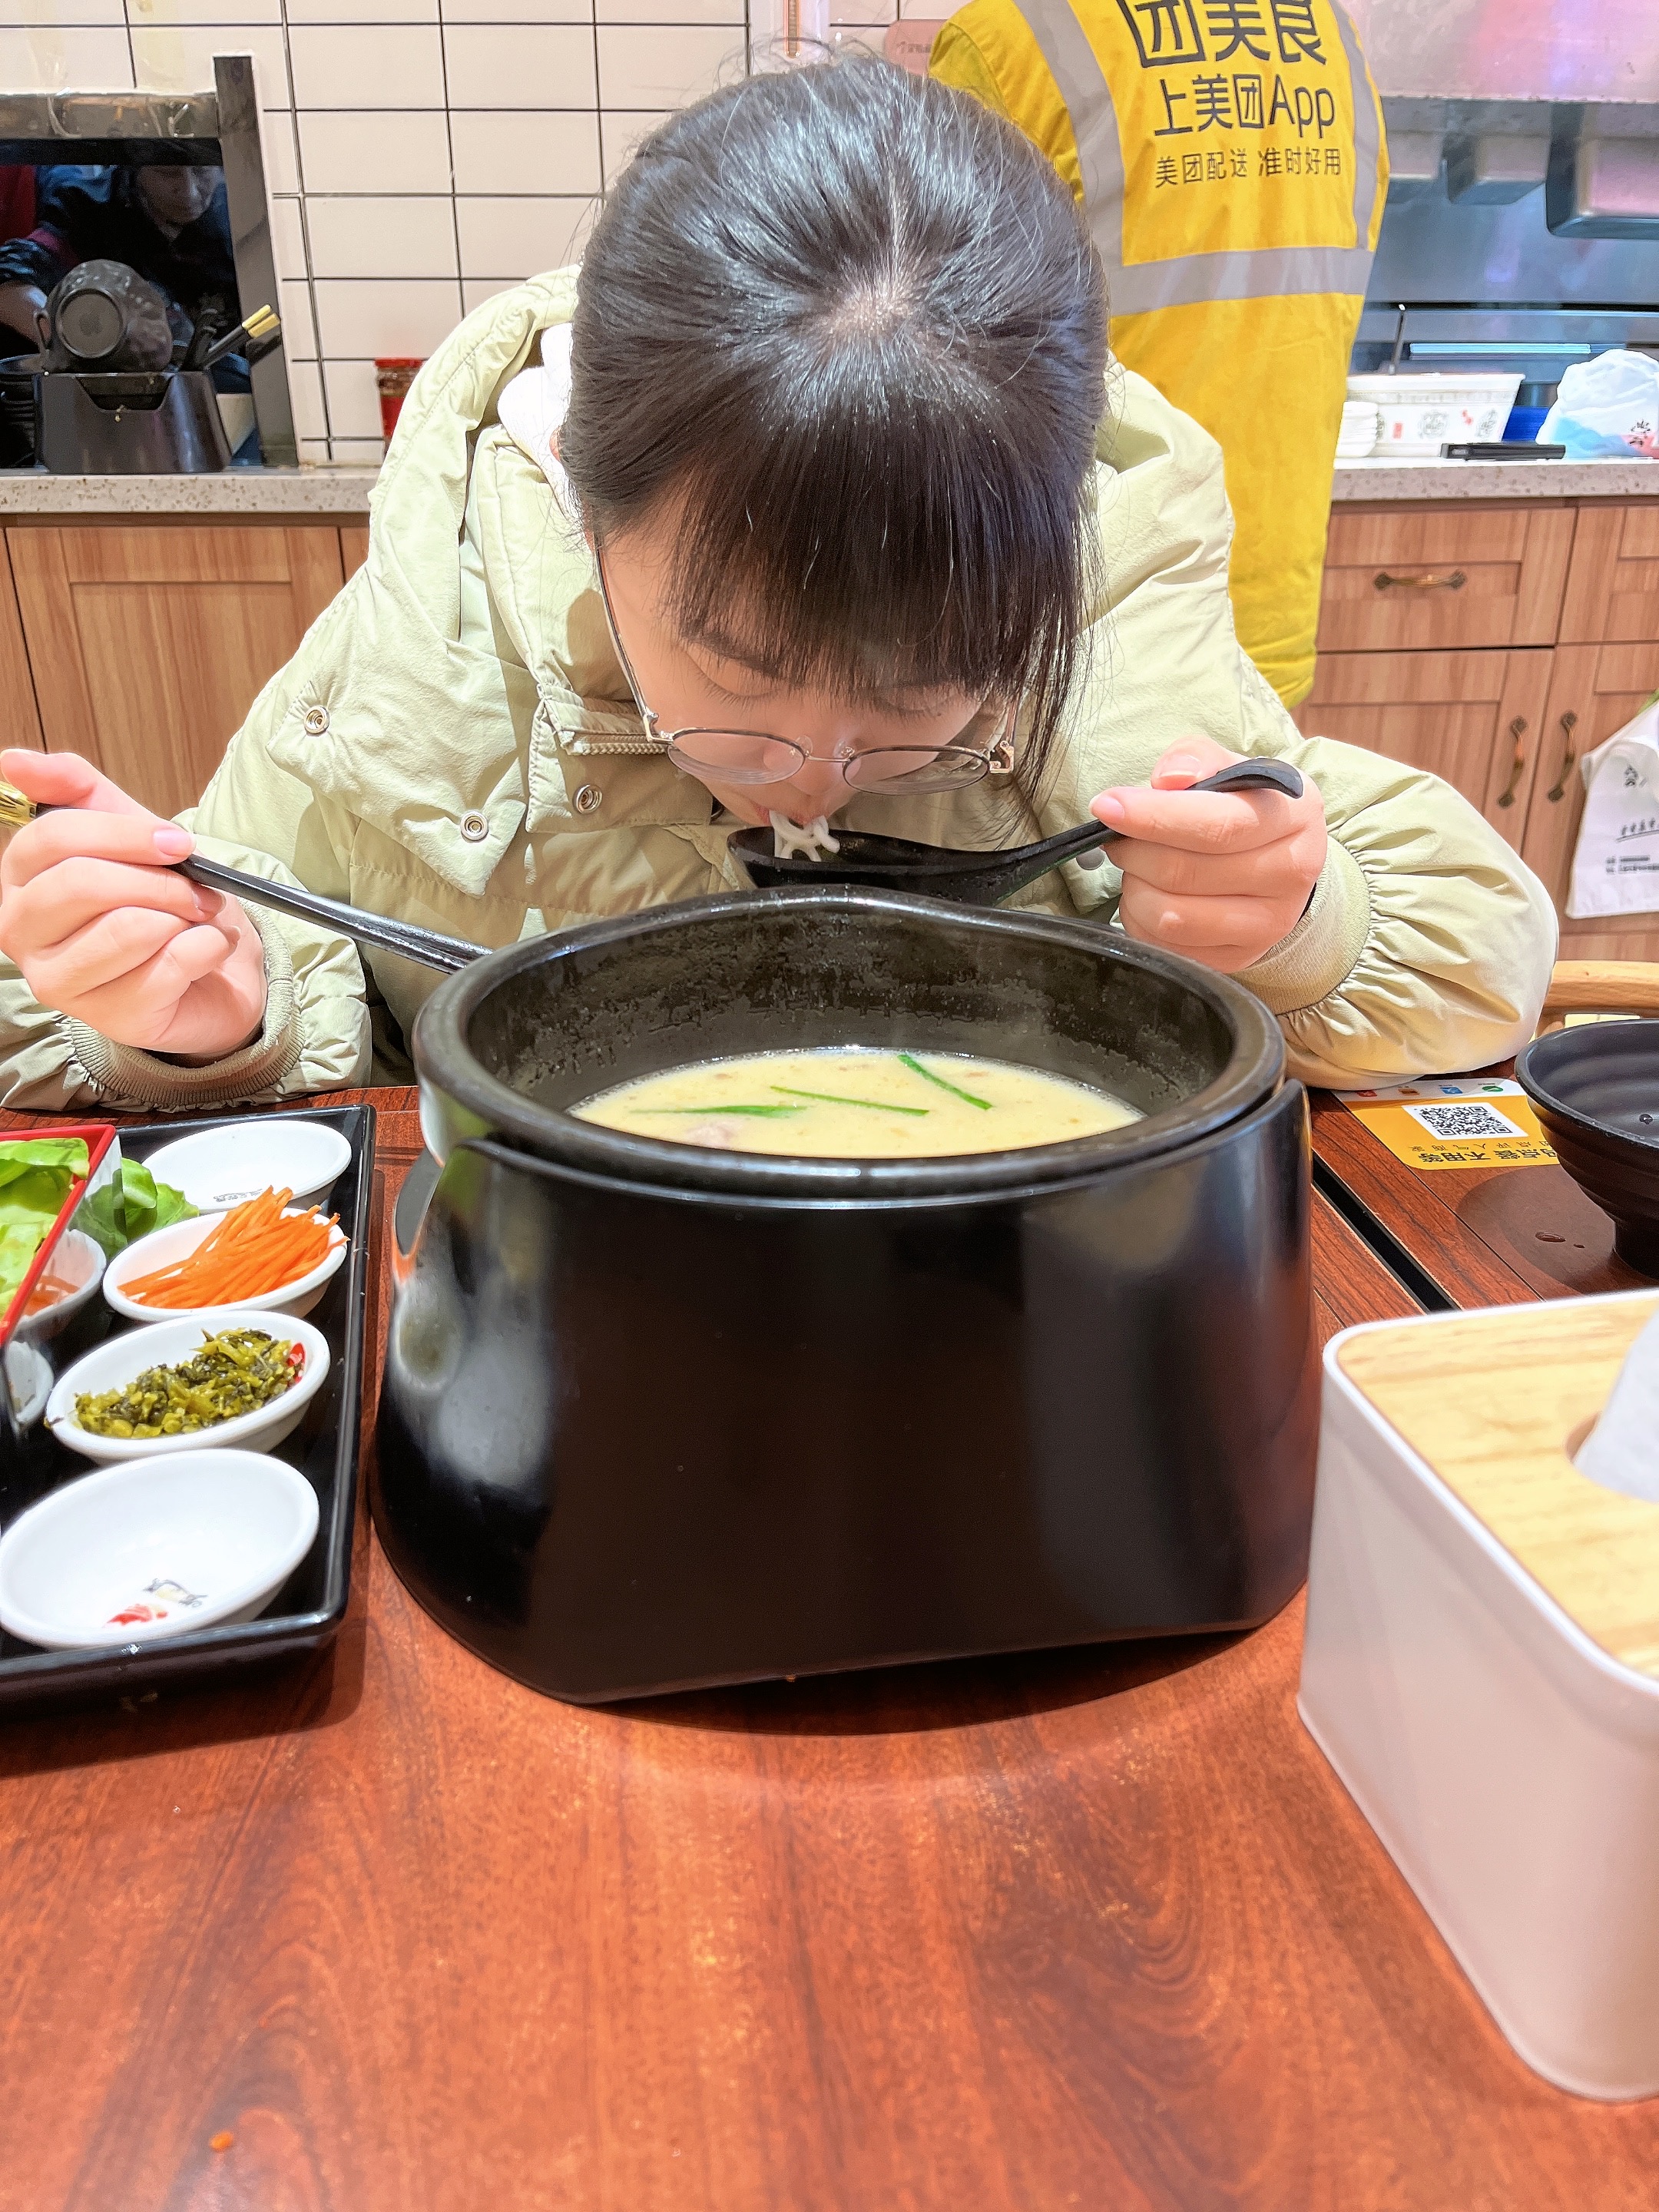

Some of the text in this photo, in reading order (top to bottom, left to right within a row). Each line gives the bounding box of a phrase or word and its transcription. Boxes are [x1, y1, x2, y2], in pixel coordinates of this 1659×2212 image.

[1154, 73, 1336, 139] 上美团App
[1155, 146, 1342, 188] 美团配送 准时好用
